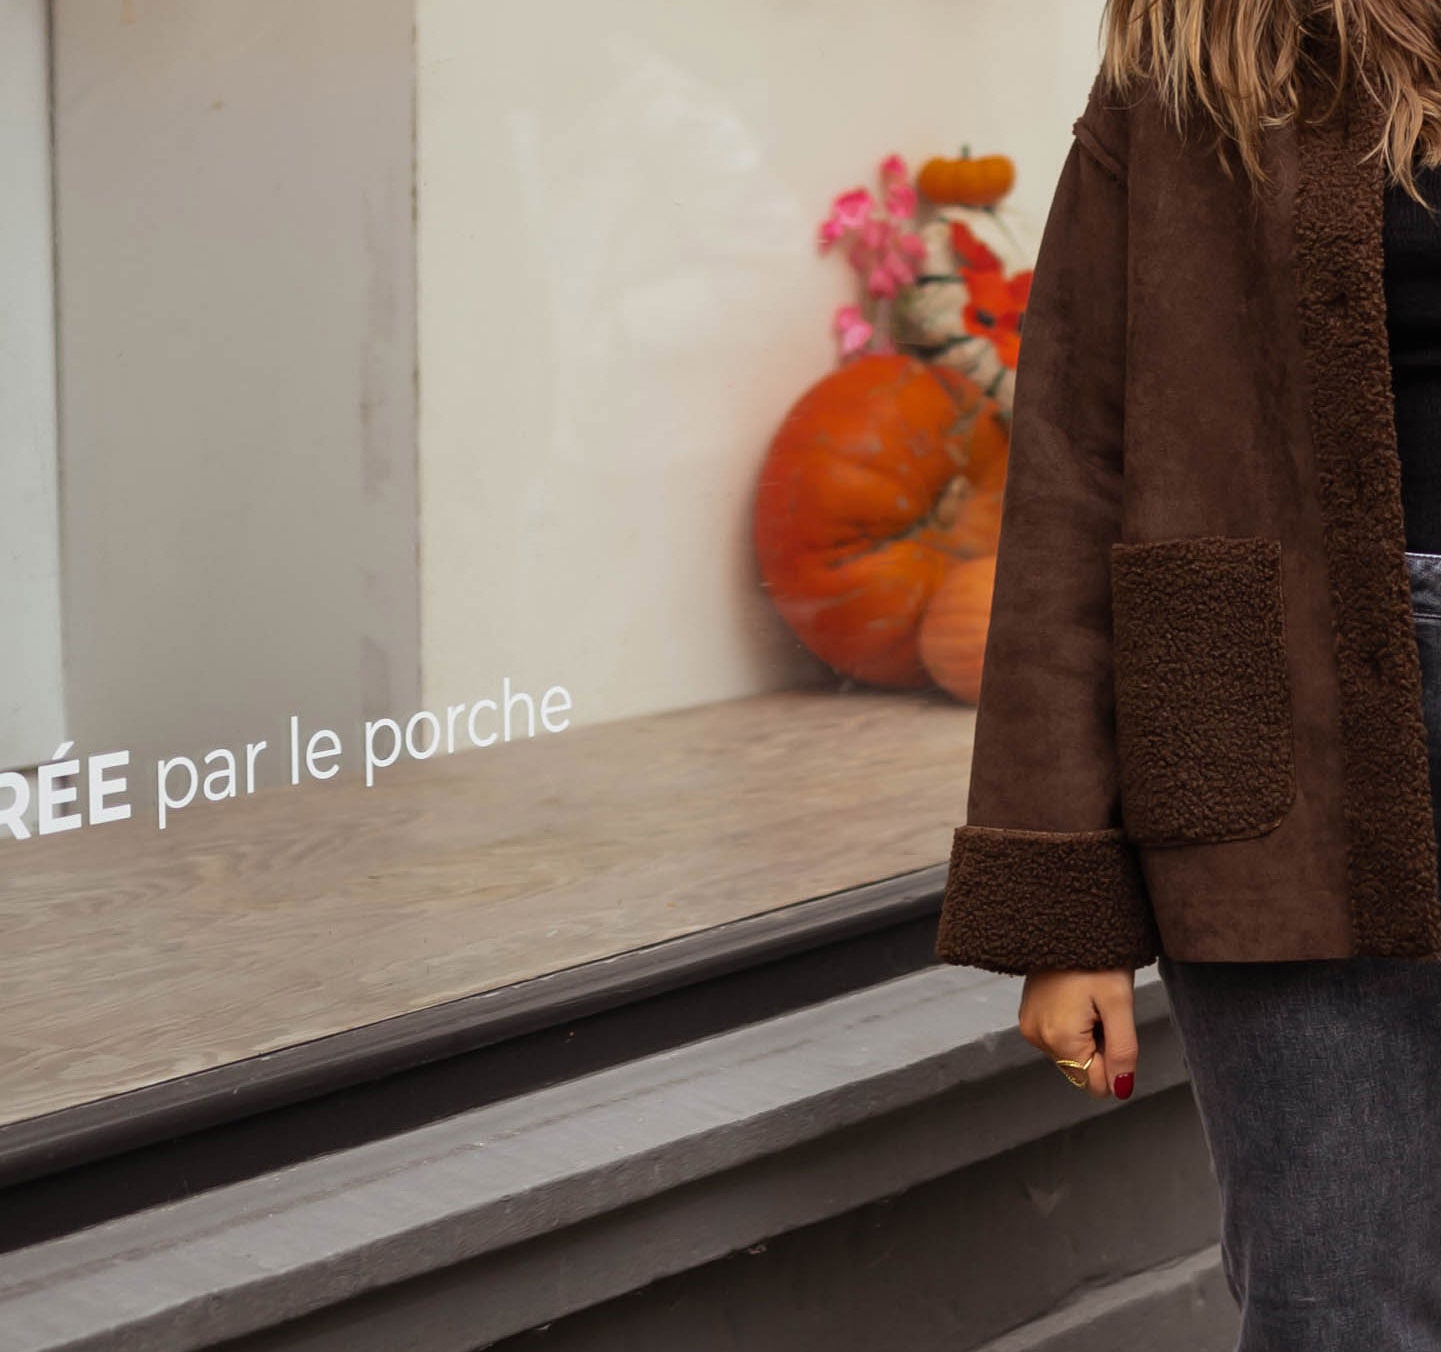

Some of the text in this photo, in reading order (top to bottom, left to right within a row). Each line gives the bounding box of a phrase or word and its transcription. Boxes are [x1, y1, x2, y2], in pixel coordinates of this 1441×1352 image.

[157, 740, 268, 831] par
[289, 714, 343, 786] le
[364, 677, 573, 788] porche
